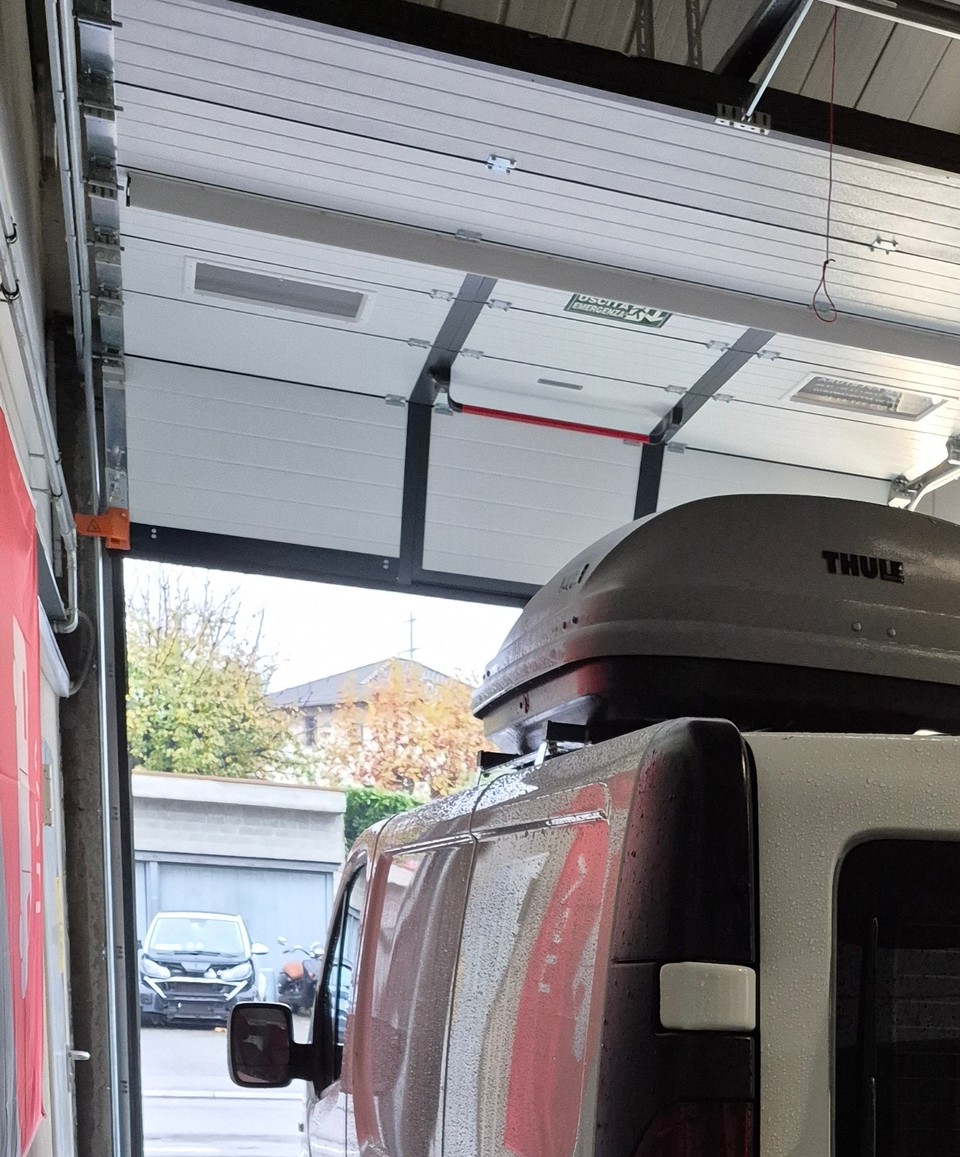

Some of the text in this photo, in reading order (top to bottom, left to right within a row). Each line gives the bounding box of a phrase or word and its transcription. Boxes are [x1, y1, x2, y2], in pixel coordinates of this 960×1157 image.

[571, 301, 626, 318] EMERGENZA
[577, 294, 628, 309] USCITA
[822, 550, 904, 585] THULE
